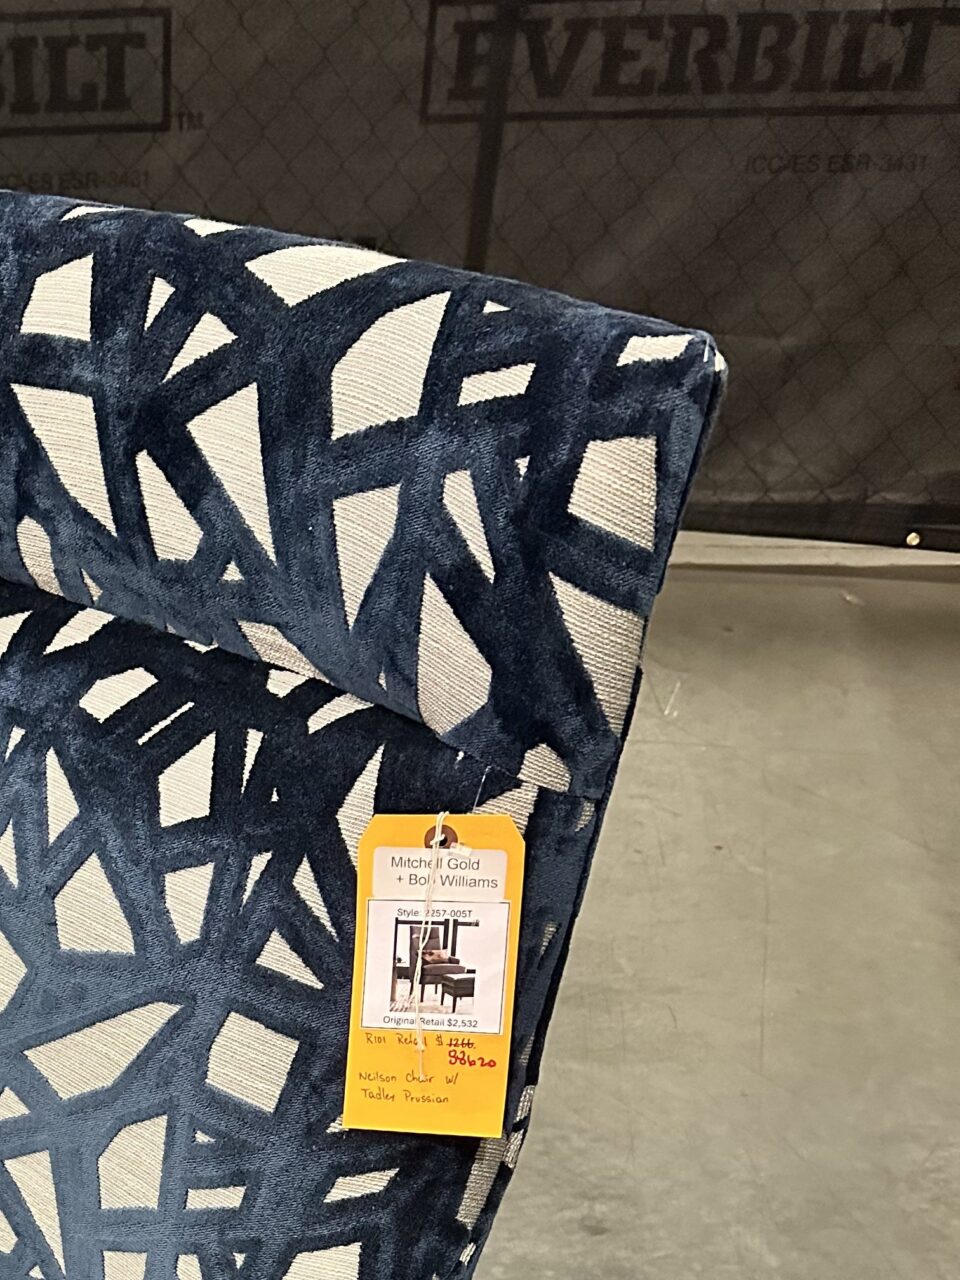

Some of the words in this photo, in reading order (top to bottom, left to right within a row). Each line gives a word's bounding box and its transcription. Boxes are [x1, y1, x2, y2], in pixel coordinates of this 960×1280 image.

[444, 7, 952, 99] EVERBILT
[391, 856, 443, 870] Mitchell
[447, 857, 481, 871] Gold
[396, 874, 404, 884] +
[440, 874, 499, 889] Williams
[382, 1015, 417, 1027] Original
[419, 1017, 445, 1027] Retail
[447, 1018, 479, 1029] $2,532
[395, 1032, 428, 1047] Retal
[405, 1069, 434, 1083] Chair
[402, 1089, 449, 1103] Prussian
